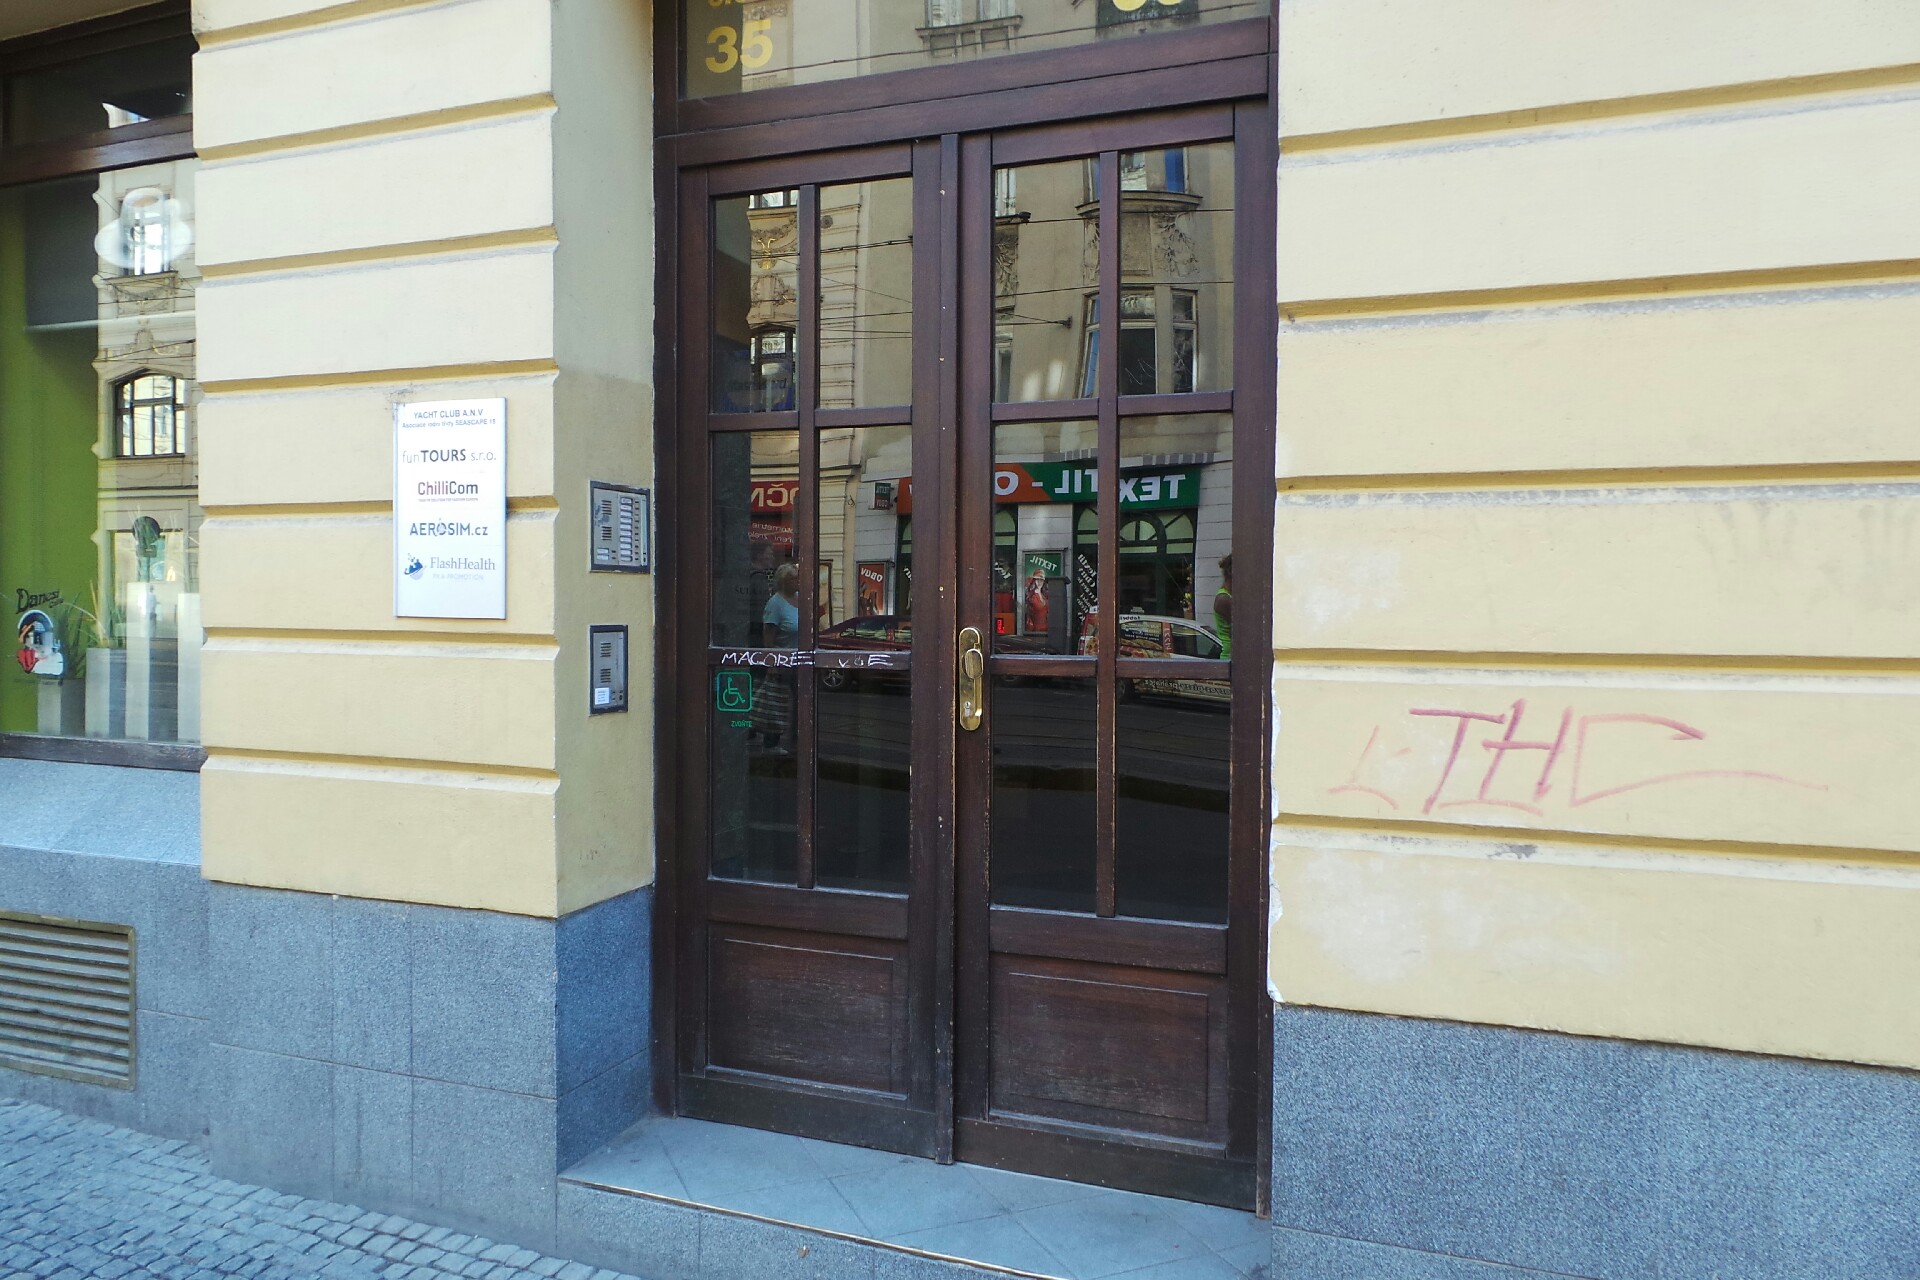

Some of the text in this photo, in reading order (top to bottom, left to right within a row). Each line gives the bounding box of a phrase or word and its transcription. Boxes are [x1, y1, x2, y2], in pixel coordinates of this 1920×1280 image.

[705, 18, 773, 74] 35
[414, 411, 438, 419] YACHT
[439, 410, 461, 418] CLUB
[470, 452, 497, 462] s.r.o.
[417, 480, 479, 496] ChilliCom
[430, 556, 496, 571] FlashHealth
